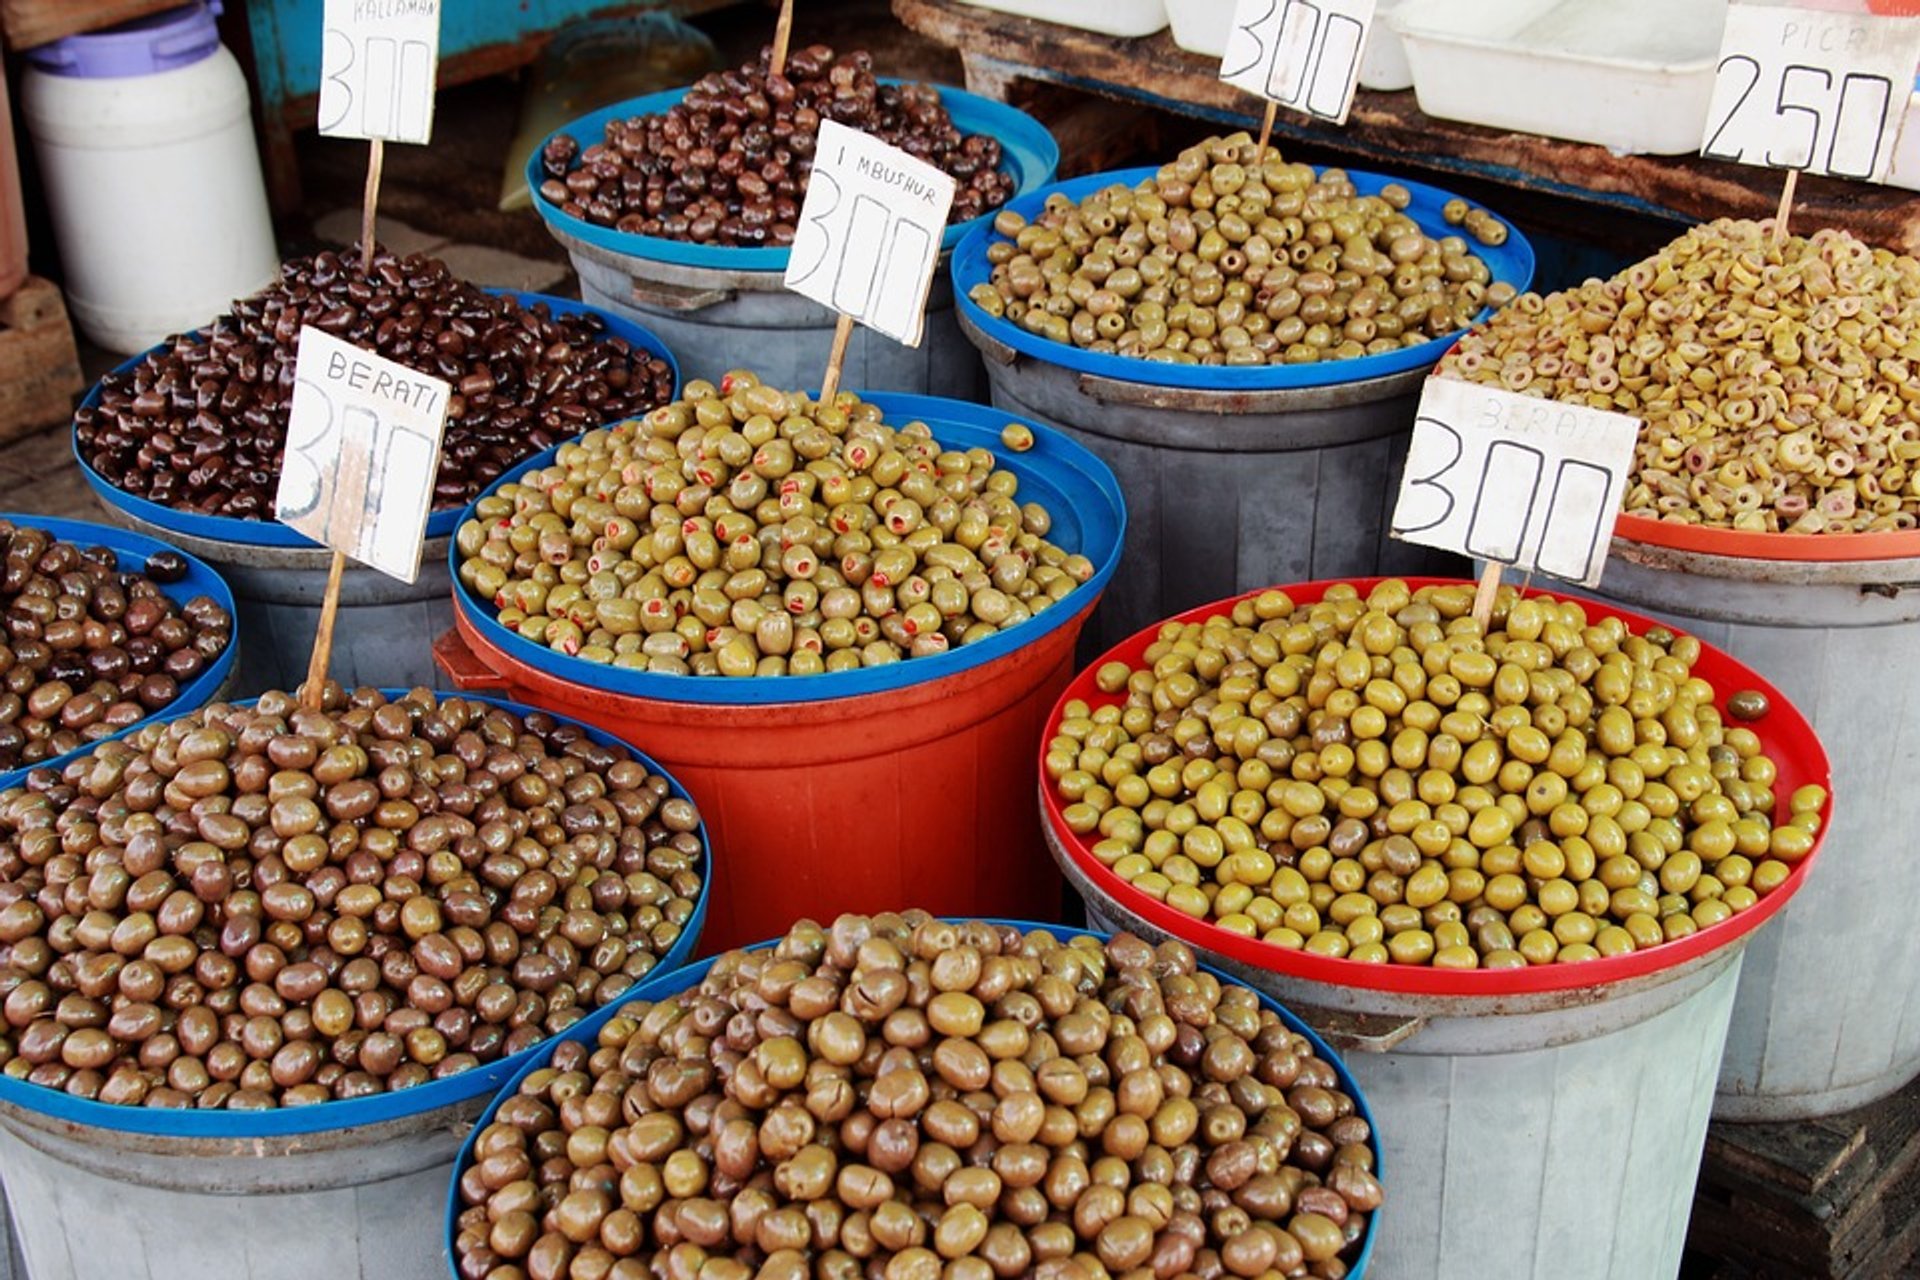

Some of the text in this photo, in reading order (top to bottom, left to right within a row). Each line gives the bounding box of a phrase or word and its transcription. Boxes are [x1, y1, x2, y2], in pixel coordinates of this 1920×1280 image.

[318, 28, 432, 141] 300
[1220, 0, 1364, 119] 300
[1701, 54, 1893, 180] 250
[856, 156, 937, 206] MBUSHUR
[787, 167, 932, 339] 300
[327, 350, 438, 414] BERATI
[1476, 397, 1613, 442] BERATI
[279, 377, 436, 578] 300
[1391, 415, 1613, 583] 300
